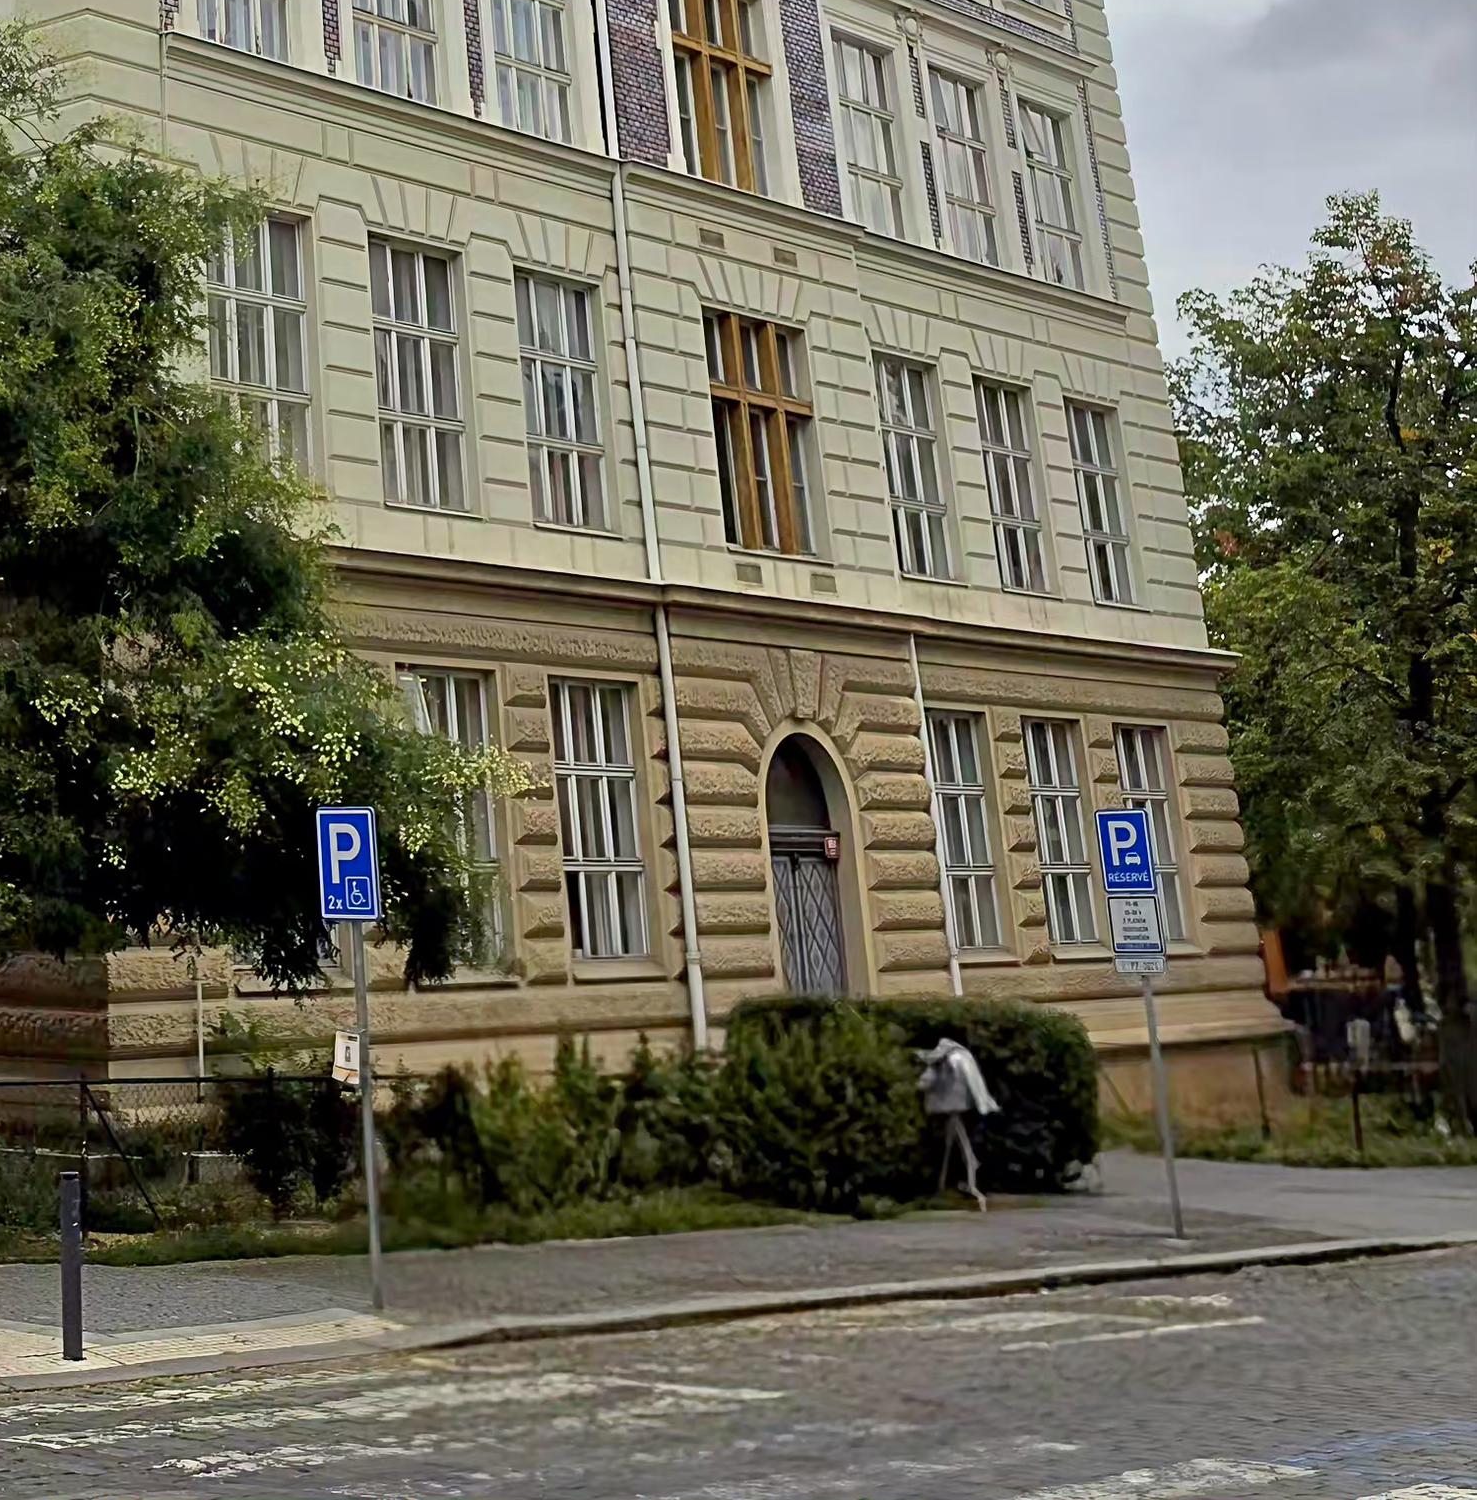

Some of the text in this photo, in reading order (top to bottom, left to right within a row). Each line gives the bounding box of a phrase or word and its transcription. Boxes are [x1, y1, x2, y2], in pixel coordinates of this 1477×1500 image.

[329, 823, 361, 883] P
[1107, 820, 1137, 866] P
[328, 895, 343, 909] 2x
